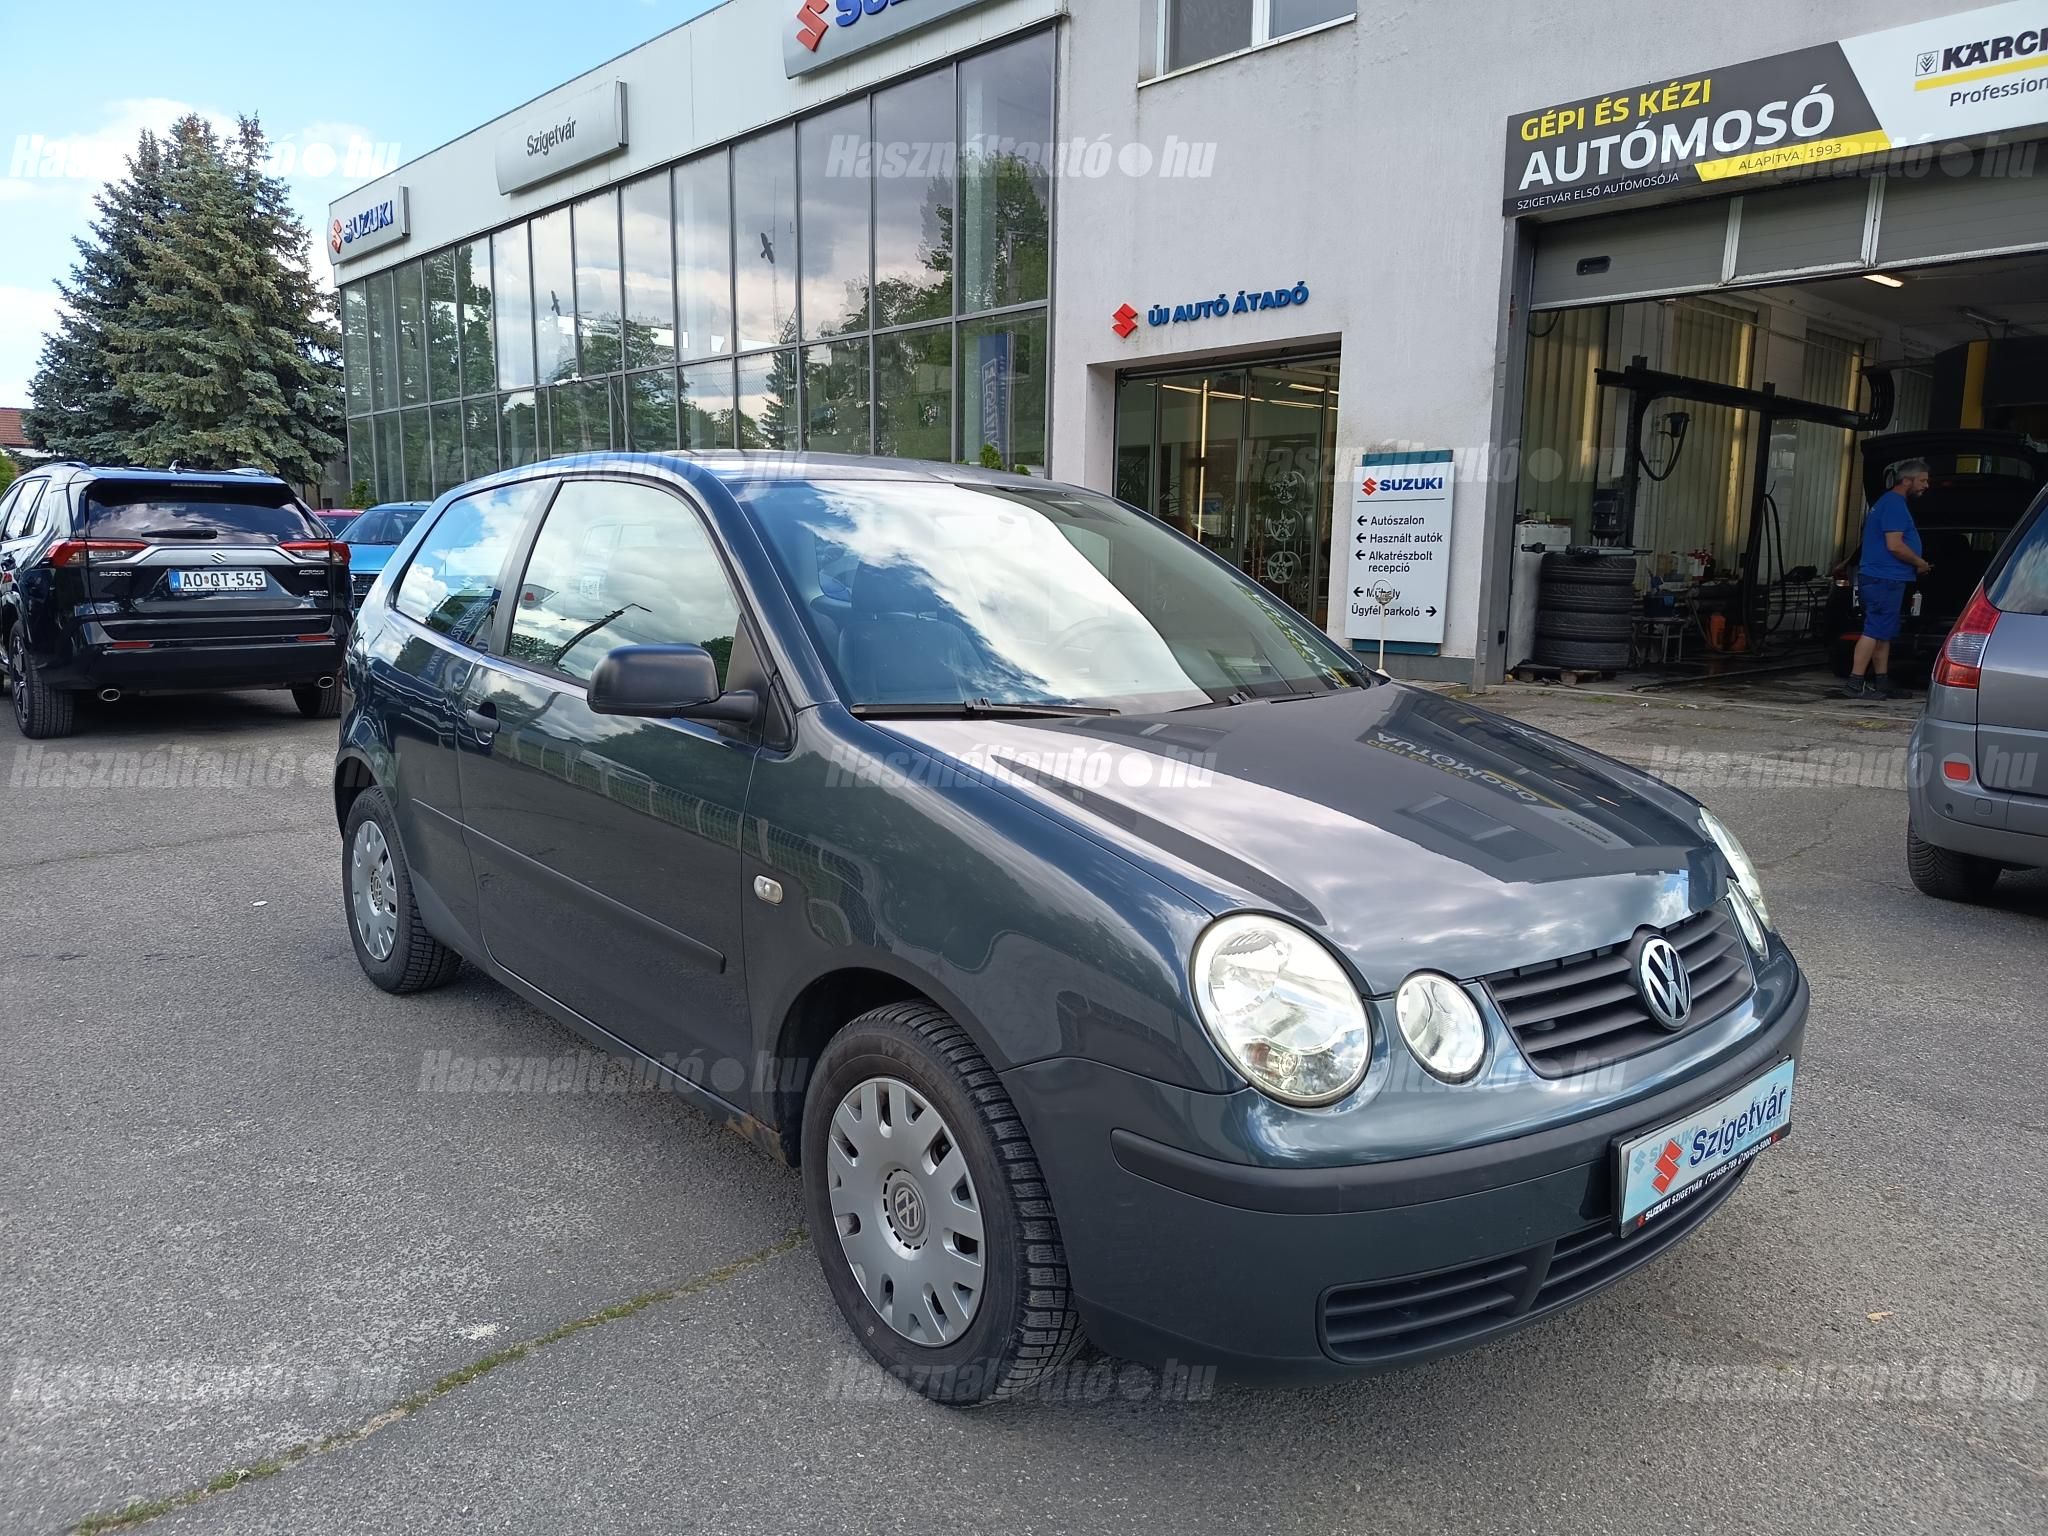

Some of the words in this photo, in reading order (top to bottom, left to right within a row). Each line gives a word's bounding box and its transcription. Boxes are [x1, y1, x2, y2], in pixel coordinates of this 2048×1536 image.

[1521, 107, 1585, 141] GÉPI
[1595, 97, 1629, 126] ÉS
[1638, 79, 1711, 117] KÉZI
[527, 117, 576, 156] Szigetvár
[1518, 83, 1835, 190] AUTÓMOSÓ
[1808, 143, 1842, 157] 1993
[1517, 191, 1571, 210] SZIGETVÁR
[1603, 172, 1679, 194] AUTÓMOSÓJA
[343, 200, 393, 243] SUZUKI
[1148, 304, 1170, 327] ÚJ
[1173, 294, 1230, 323] AUTÓ
[1232, 281, 1310, 314] ÁTADÓ
[1379, 477, 1443, 491] SUZUKI
[1370, 515, 1425, 526] Autószalon
[1370, 533, 1411, 544] Használt
[1414, 532, 1443, 543] autók
[1368, 562, 1410, 574] recepció
[1369, 550, 1432, 561] Alkatrészbolt
[183, 573, 203, 587] AO
[210, 573, 263, 587] QT-545
[1351, 603, 1381, 617] Ügyfél
[1384, 606, 1420, 618] parkoló
[1689, 1083, 1788, 1168] Szigetvár
[1645, 1198, 1671, 1220] SUZUKI
[1672, 1180, 1703, 1204] SZIGETVÁR
